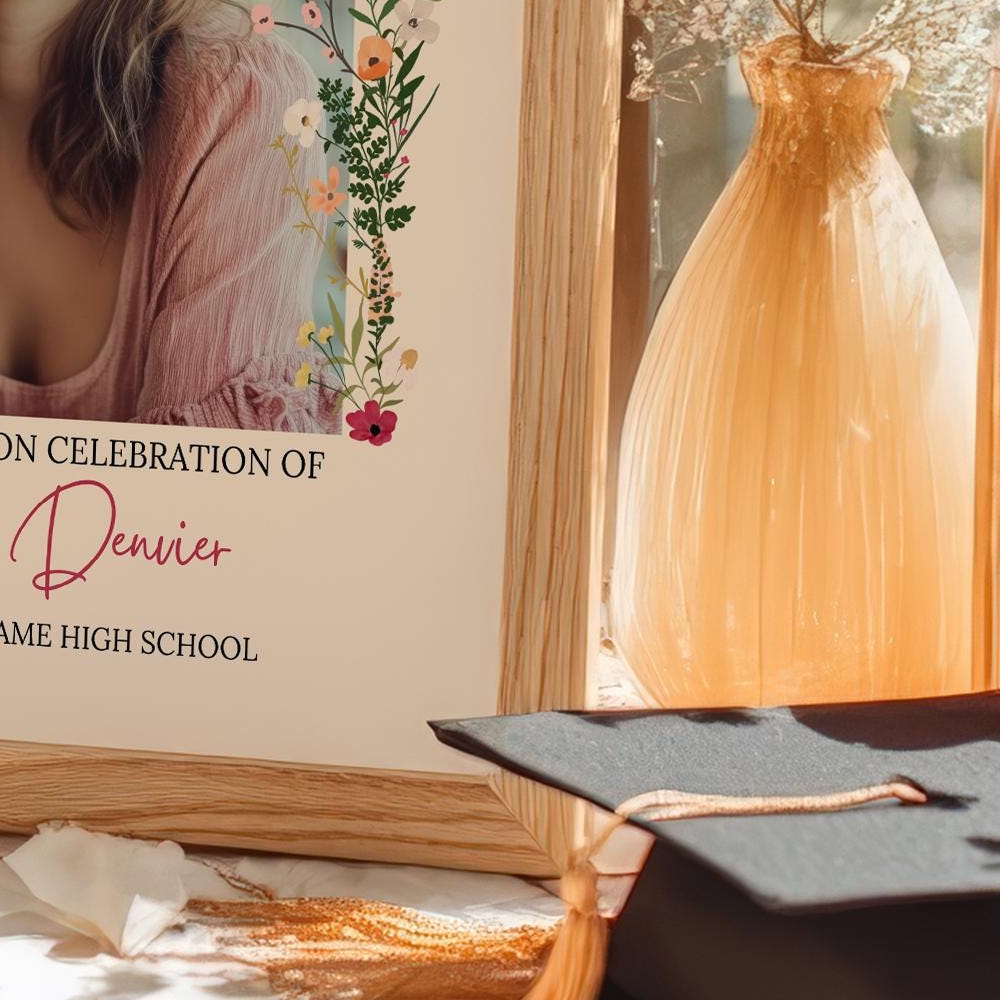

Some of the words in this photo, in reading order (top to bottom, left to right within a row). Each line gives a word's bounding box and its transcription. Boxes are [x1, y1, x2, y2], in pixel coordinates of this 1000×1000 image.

[47, 436, 272, 477] CELEBRATION
[281, 449, 327, 480] OF
[60, 624, 133, 653] HIGH
[141, 629, 258, 662] SCHOOL
